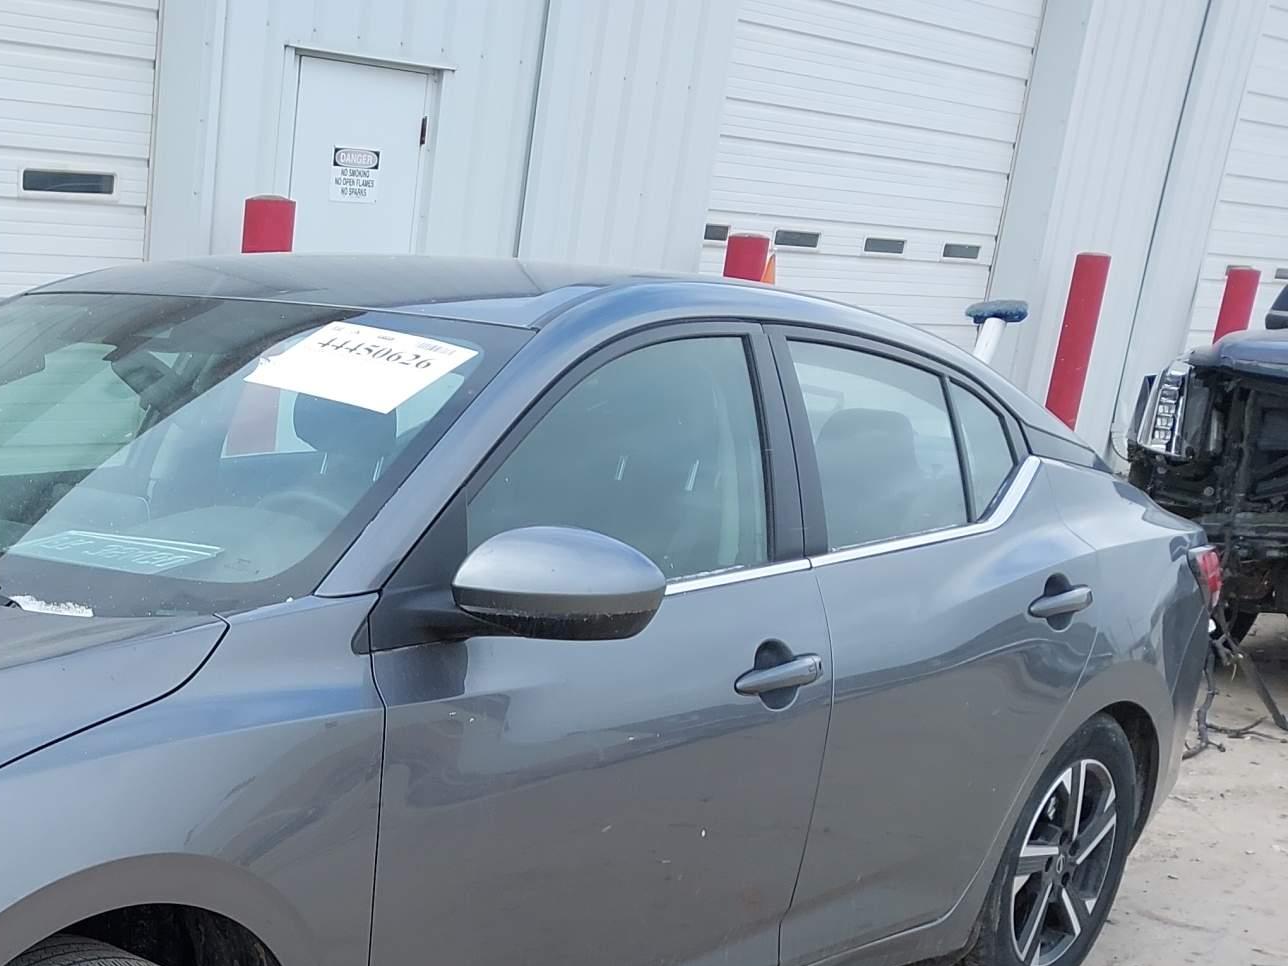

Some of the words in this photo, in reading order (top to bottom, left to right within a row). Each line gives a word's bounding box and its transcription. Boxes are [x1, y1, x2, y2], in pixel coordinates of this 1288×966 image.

[340, 152, 373, 165] DANGER
[349, 169, 370, 178] SMOKING
[335, 177, 341, 185] NO
[343, 178, 355, 186] OPEN
[356, 179, 374, 188] FLAMES
[342, 187, 348, 195] NO
[349, 188, 367, 196] SPARKS
